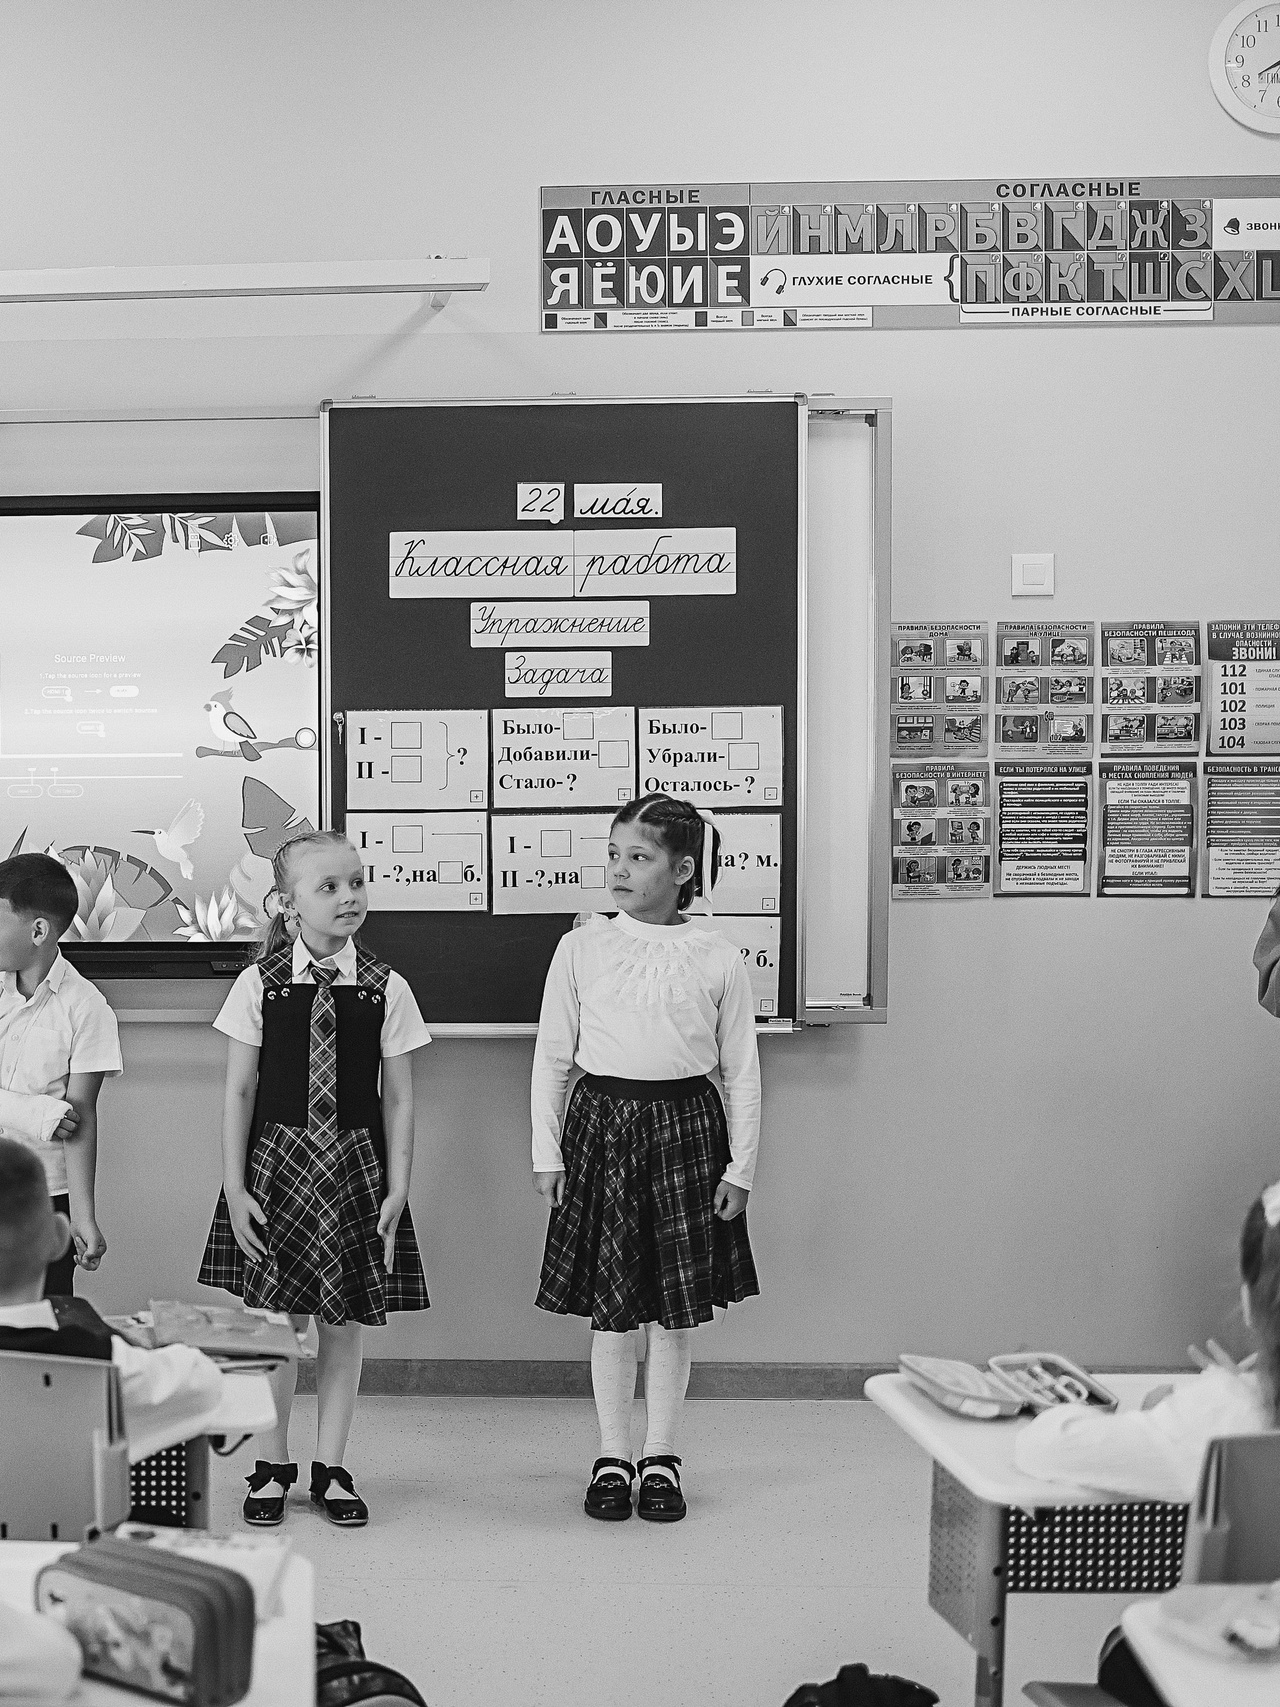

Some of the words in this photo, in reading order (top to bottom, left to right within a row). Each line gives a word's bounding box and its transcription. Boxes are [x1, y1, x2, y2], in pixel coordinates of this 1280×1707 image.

[1257, 20, 1268, 32] 11
[1241, 35, 1256, 48] 10
[1235, 55, 1245, 68] 9
[1242, 75, 1250, 88] 8
[1259, 90, 1267, 102] 7
[996, 181, 1141, 198] СОГЛАСНЫЕ
[591, 189, 700, 205] ГЛАСНЫЕ
[792, 275, 843, 286] ГЛУХИЕ
[847, 274, 933, 286] СОГЛАСНЫЕ
[1012, 307, 1073, 317] ПАРНЫЕ
[1076, 305, 1162, 316] СОГЛАСНЫЕ
[521, 487, 561, 513] 22
[395, 539, 569, 579] Классная
[580, 535, 732, 593] работа
[474, 606, 647, 647] Упражнение
[1158, 629, 1196, 637] ПЕШЕХОДА
[1211, 623, 1241, 631] ЗАПОМНИ
[54, 654, 87, 663] Source
[89, 653, 126, 663] Preview
[1231, 647, 1277, 660] ЗВОНИ!
[507, 654, 610, 696] Задача
[1221, 664, 1247, 677] 112
[1220, 682, 1246, 695] 101
[1220, 699, 1247, 713] 102
[1220, 717, 1246, 731] 103
[1218, 735, 1246, 749] 104
[1113, 764, 1142, 772] ПРАВИЛА
[1143, 764, 1180, 772] ПОВЕДЕНИЯ
[895, 771, 945, 779] БЕЗОПАСНОСТИ
[1171, 771, 1194, 779] ЛЮДЕЙ
[755, 854, 779, 868] м.
[755, 949, 774, 968] б.
